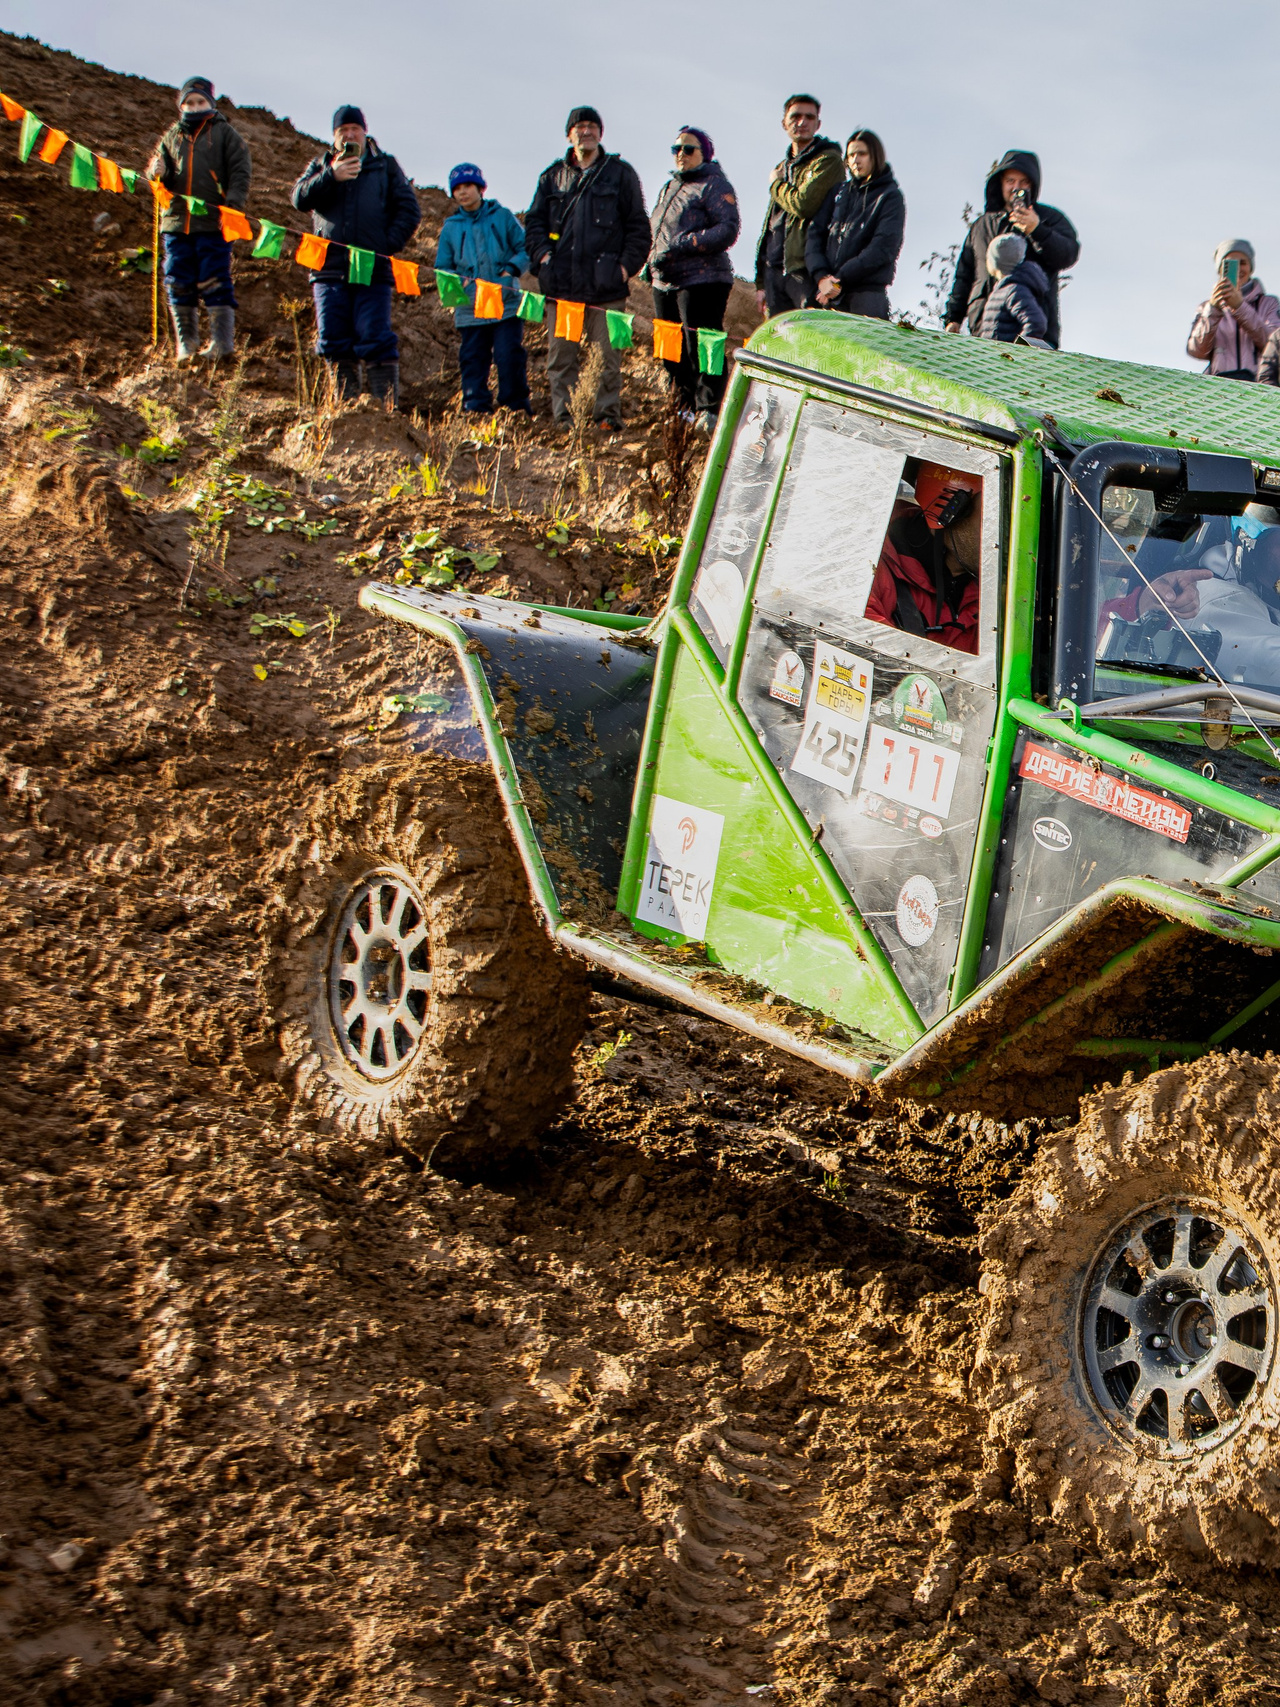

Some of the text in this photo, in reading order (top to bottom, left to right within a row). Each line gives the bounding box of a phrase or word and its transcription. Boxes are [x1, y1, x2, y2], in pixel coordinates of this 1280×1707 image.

[828, 694, 854, 714] ГОРЫ
[831, 684, 853, 701] ЦАРЬ
[805, 720, 859, 777] 425
[1025, 751, 1187, 833] ДРУГИЕ МЕТИЗЫ
[1035, 823, 1070, 846] SINTEC
[649, 860, 711, 908] ТЕРЕК
